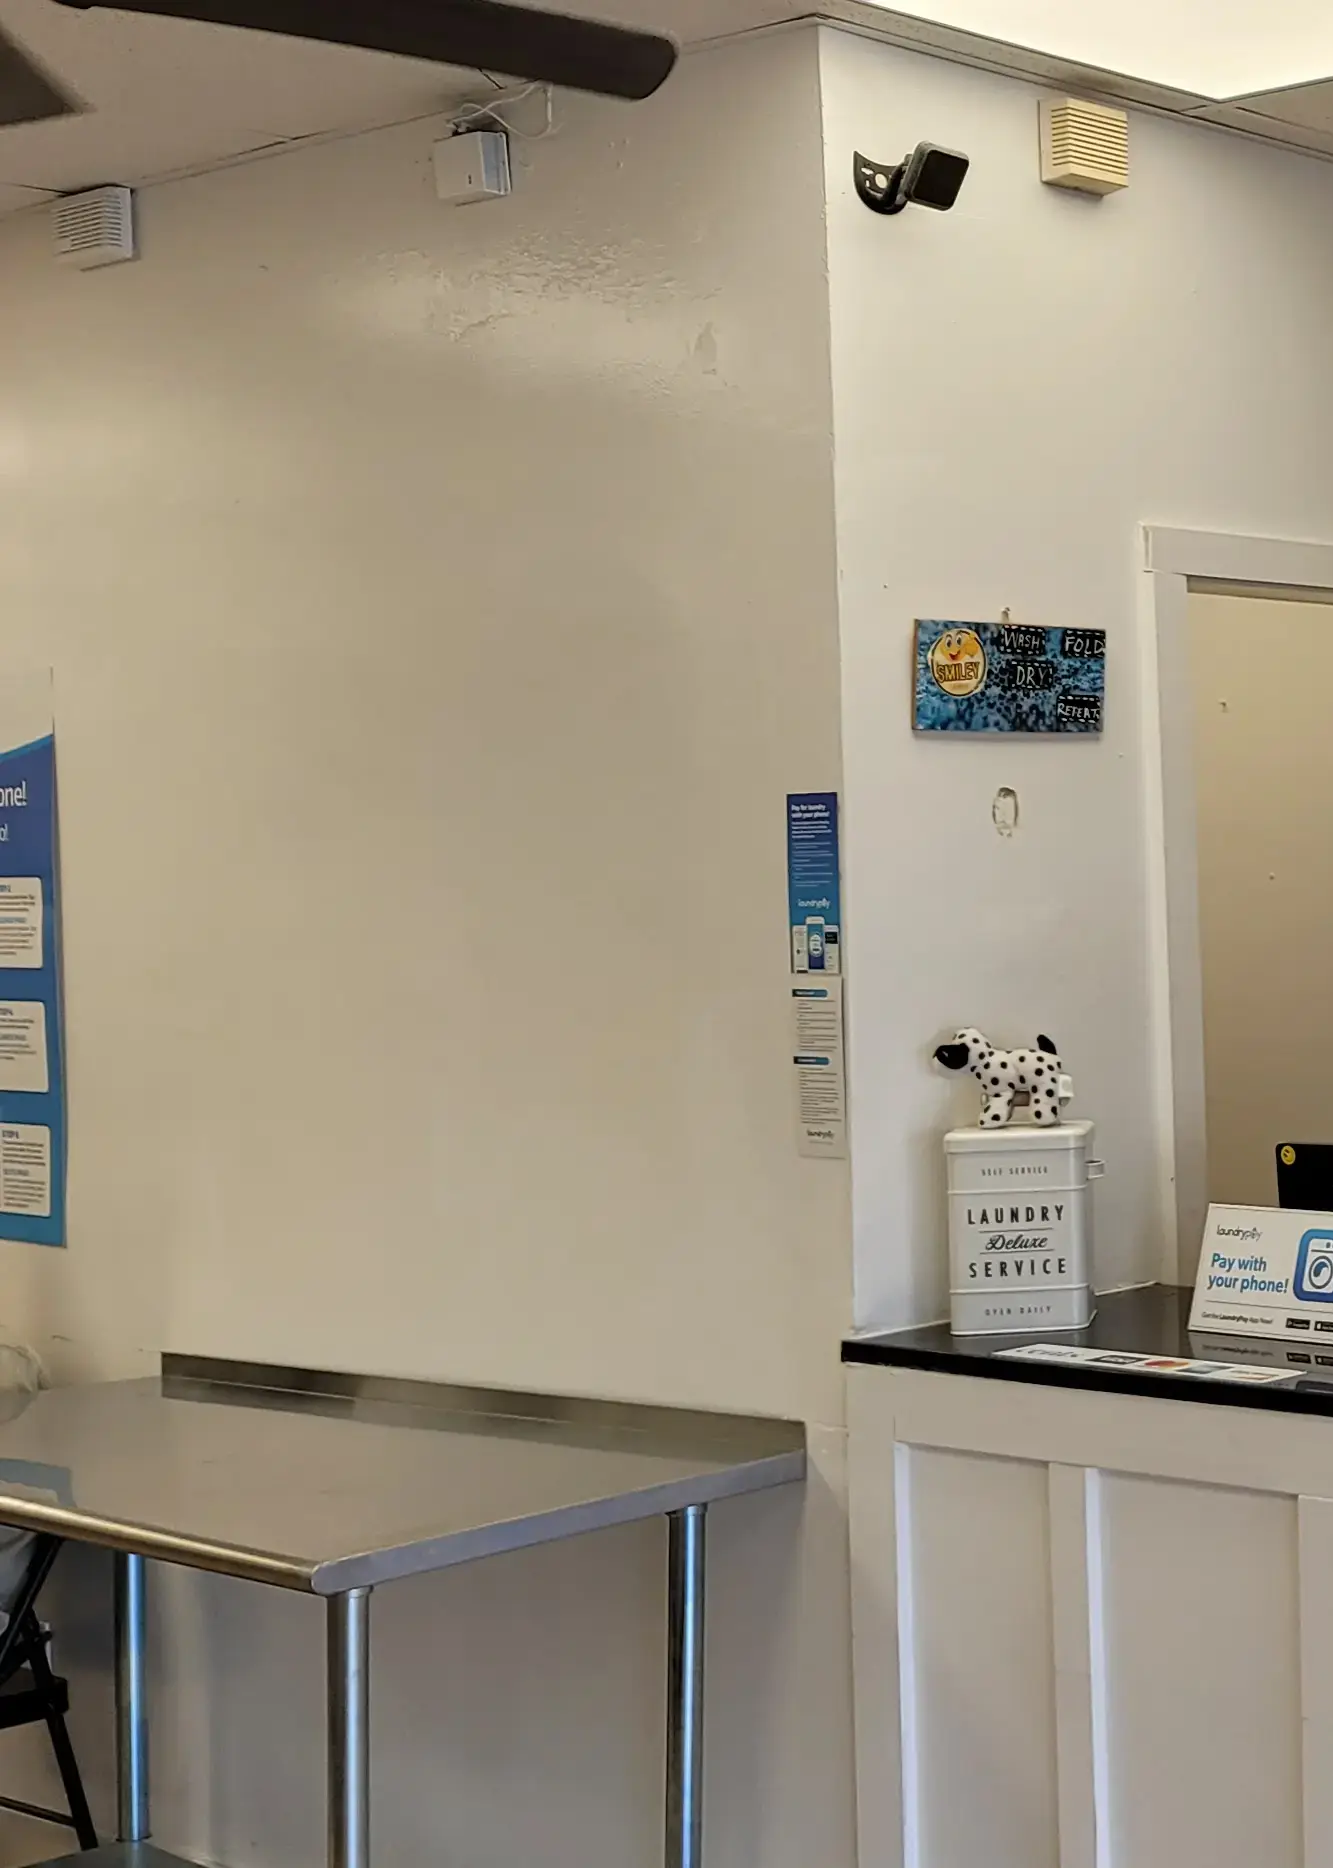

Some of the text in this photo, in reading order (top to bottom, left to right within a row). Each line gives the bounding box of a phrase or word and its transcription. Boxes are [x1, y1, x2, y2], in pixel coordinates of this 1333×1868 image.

[1004, 630, 1041, 650] WASH
[1064, 636, 1105, 655] FOLD
[936, 660, 980, 684] SMILEY
[1016, 666, 1047, 686] DRY
[967, 1205, 1065, 1225] LAUNDRY
[985, 1234, 1049, 1251] Deluxe
[968, 1258, 1067, 1279] SERVICE
[1211, 1252, 1267, 1273] Pay with
[1206, 1275, 1290, 1294] your phone!
